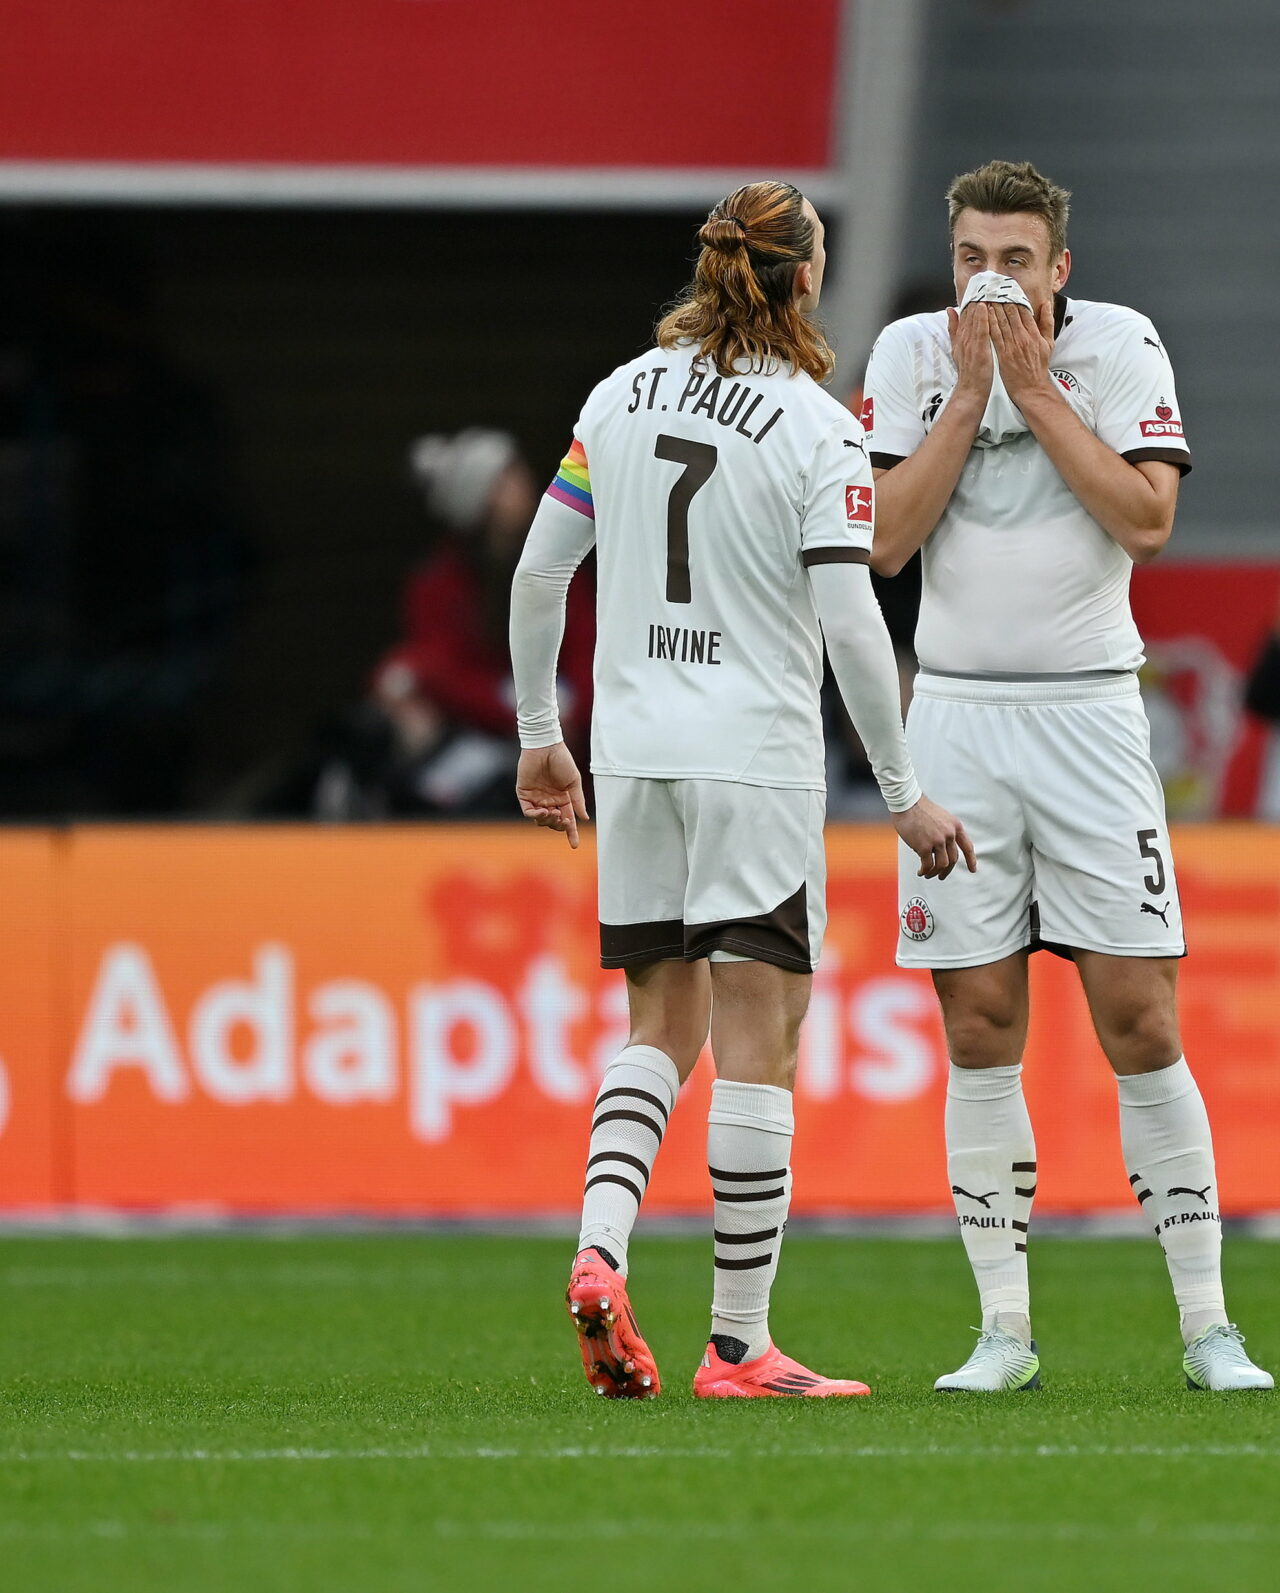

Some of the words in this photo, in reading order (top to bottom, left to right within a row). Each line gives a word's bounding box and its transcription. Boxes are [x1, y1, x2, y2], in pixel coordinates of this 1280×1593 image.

[628, 367, 668, 413] ST.
[677, 376, 784, 444] PAULI
[654, 434, 718, 603] 7
[648, 624, 722, 665] IRVINE
[1137, 829, 1166, 895] 5
